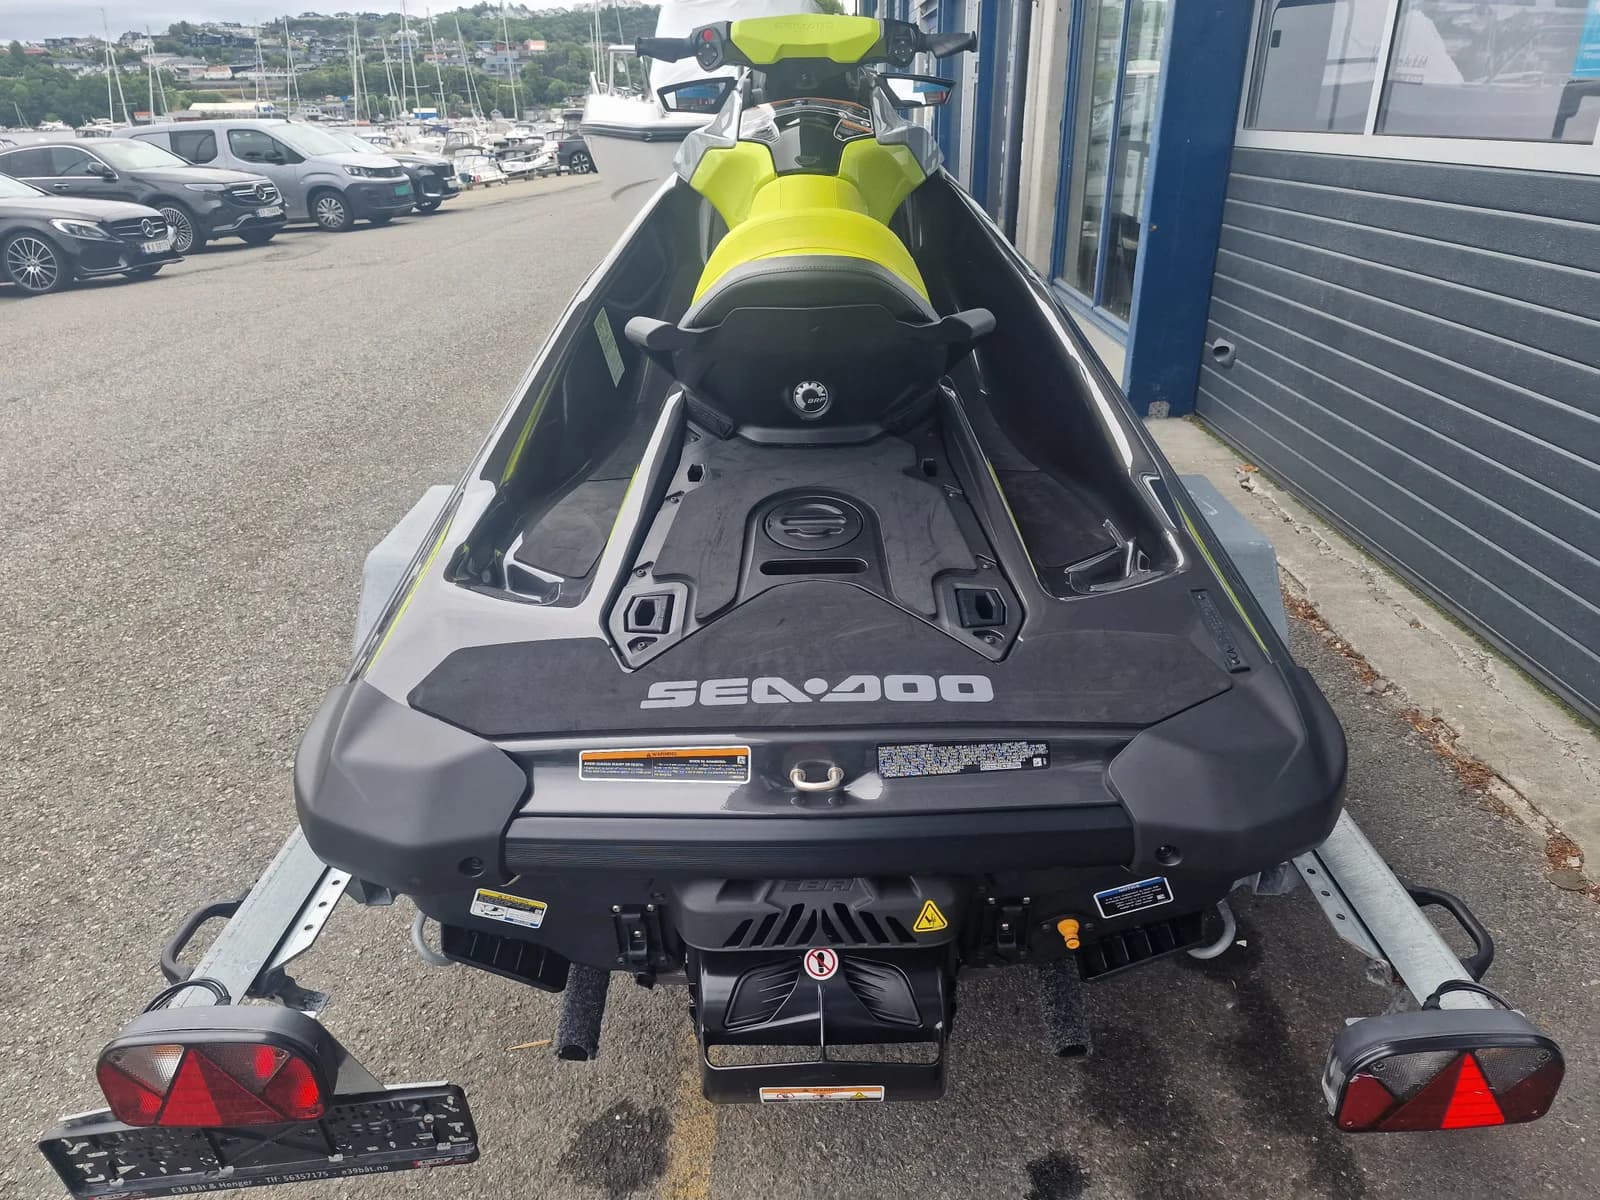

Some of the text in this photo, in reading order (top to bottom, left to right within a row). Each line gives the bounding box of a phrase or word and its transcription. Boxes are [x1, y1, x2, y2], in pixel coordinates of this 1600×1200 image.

[170, 1186, 189, 1195] E39
[190, 1184, 207, 1192] Båt
[218, 1180, 253, 1189] Henger
[282, 1171, 329, 1182] 56357175
[341, 1165, 389, 1175] e39båt.no
